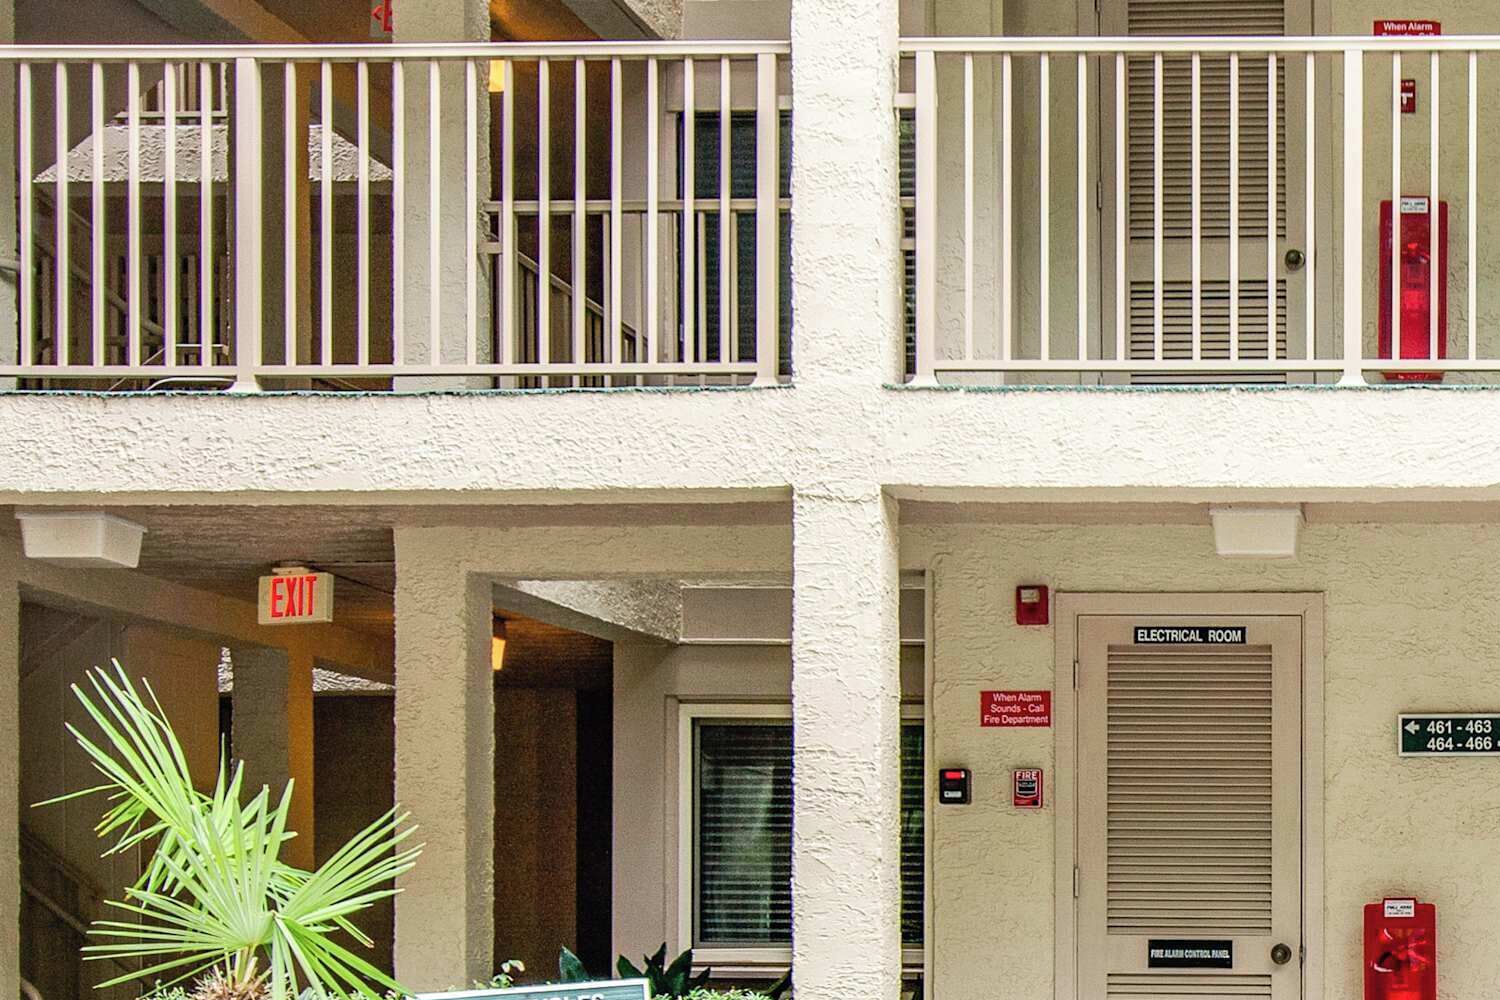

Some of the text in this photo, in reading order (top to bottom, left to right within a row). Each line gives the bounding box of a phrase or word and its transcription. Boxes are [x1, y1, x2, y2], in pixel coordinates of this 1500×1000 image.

[1383, 21, 1433, 31] When Alarm
[272, 576, 317, 617] EXIT
[1137, 629, 1242, 642] ELECTRICAL ROOM
[993, 693, 1042, 702] When Alarm
[990, 704, 1021, 714] Sounds
[1028, 704, 1045, 714] Call
[984, 715, 1049, 726] Fire Department
[1426, 720, 1452, 734] 461
[1465, 720, 1492, 734] 463
[1426, 737, 1454, 751] 464
[1465, 736, 1493, 750] 466
[1016, 771, 1037, 780] FIRE
[1150, 949, 1230, 959] FIRE ALARM CONTROL PANEL
